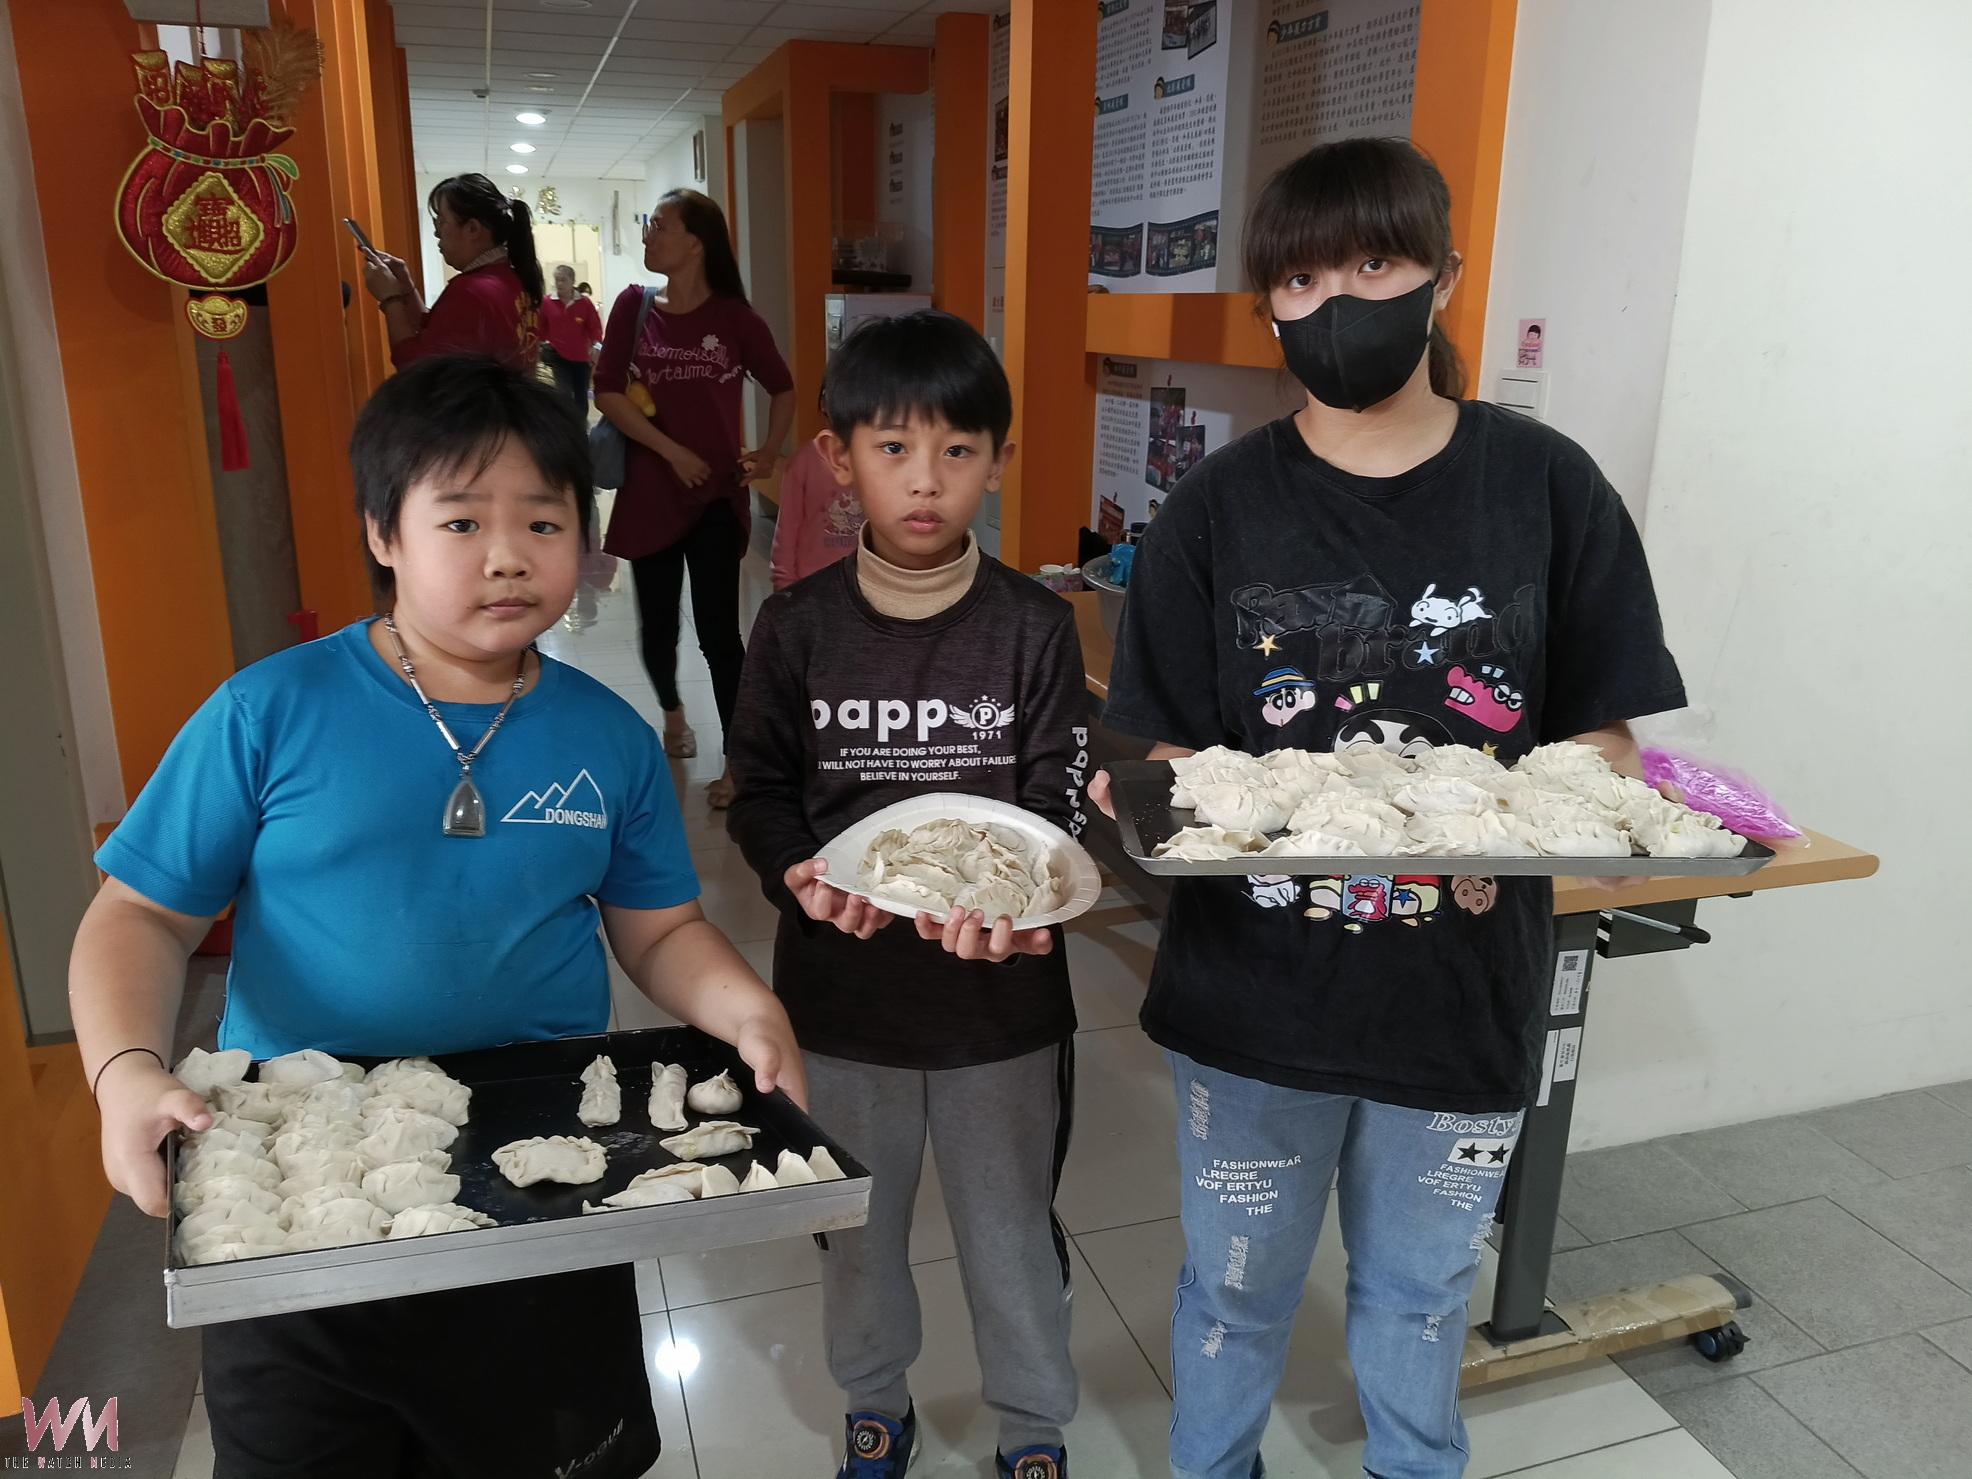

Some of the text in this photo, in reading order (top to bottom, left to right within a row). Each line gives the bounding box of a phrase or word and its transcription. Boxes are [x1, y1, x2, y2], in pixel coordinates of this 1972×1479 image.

[972, 730, 1002, 740] 1971
[839, 744, 982, 757] IF YOU ARE DOING YOUR BEST,
[822, 760, 845, 770] WILL
[845, 760, 866, 769] NOT
[866, 759, 895, 769] HAVE
[896, 759, 910, 769] TO
[910, 759, 948, 769] WORRY
[948, 757, 981, 767] ABOUT
[860, 771, 962, 781] BELIEVE IN YOURSELF.
[1213, 1154, 1302, 1170] FASHIONWEAR
[1203, 1167, 1258, 1180] LREGRE
[1427, 1170, 1474, 1182] LREGRE
[1195, 1175, 1272, 1191] VOF ERTYU
[1417, 1175, 1482, 1192] VOF ERTYU
[1219, 1190, 1279, 1204] FASHION
[1433, 1188, 1482, 1203] FASHION
[1245, 1203, 1273, 1216] THE
[1450, 1198, 1474, 1211] THE
